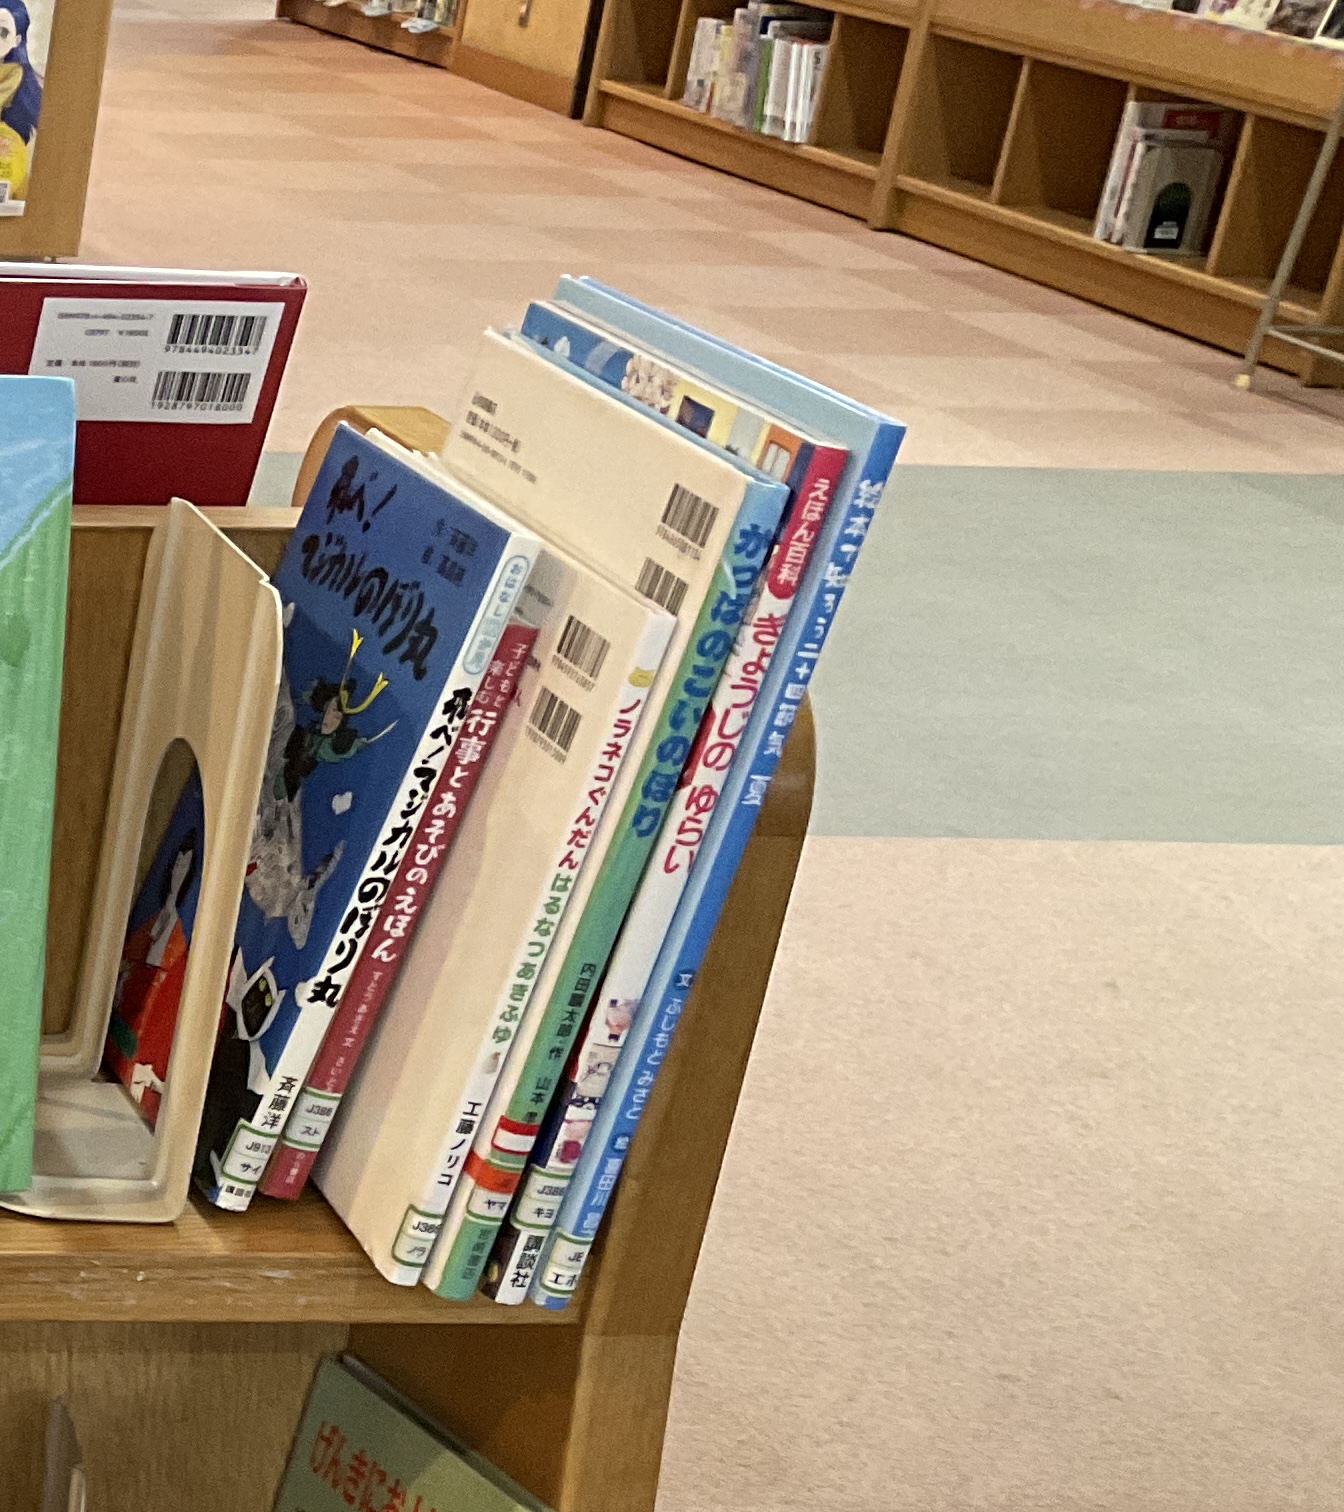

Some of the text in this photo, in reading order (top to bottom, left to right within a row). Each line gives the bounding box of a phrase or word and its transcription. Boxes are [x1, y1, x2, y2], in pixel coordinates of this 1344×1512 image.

[775, 477, 831, 587] えほん百科
[558, 698, 643, 871] ノラネコぐんだん
[662, 783, 720, 876] ゆらい
[370, 708, 498, 963] 行事とあそびのえほん
[492, 872, 572, 1043] はるなつあきふゆ
[300, 1124, 321, 1138] スト
[436, 1100, 483, 1187] 工藤ノリコ
[508, 1233, 547, 1289] 講談社
[568, 1251, 585, 1263] JE
